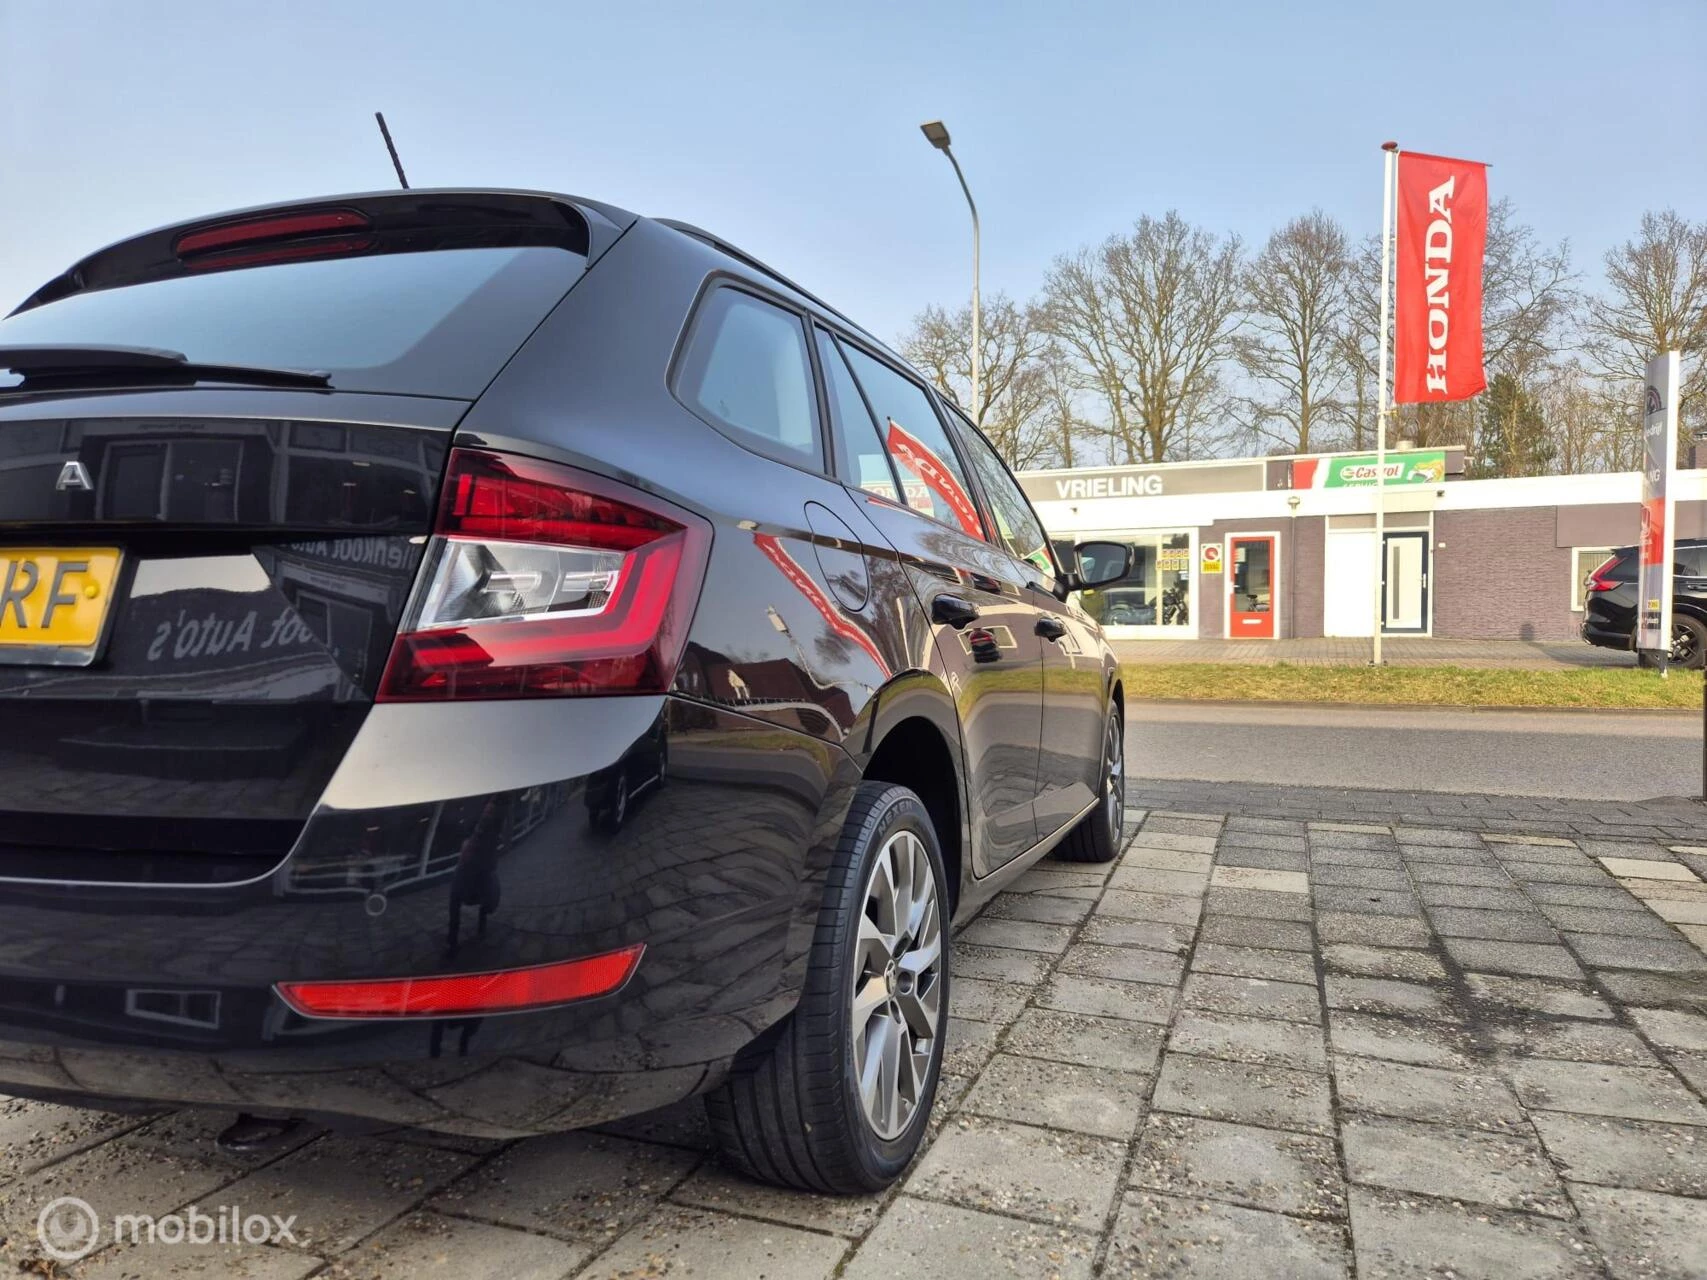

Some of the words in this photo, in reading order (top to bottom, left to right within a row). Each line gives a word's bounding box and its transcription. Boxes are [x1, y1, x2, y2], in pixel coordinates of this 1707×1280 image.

[1424, 176, 1455, 394] HONDA
[55, 461, 93, 490] A
[1056, 475, 1162, 499] VRIELING
[1355, 465, 1399, 479] Casrol
[0, 560, 88, 628] RF
[878, 800, 912, 836] NEXEN
